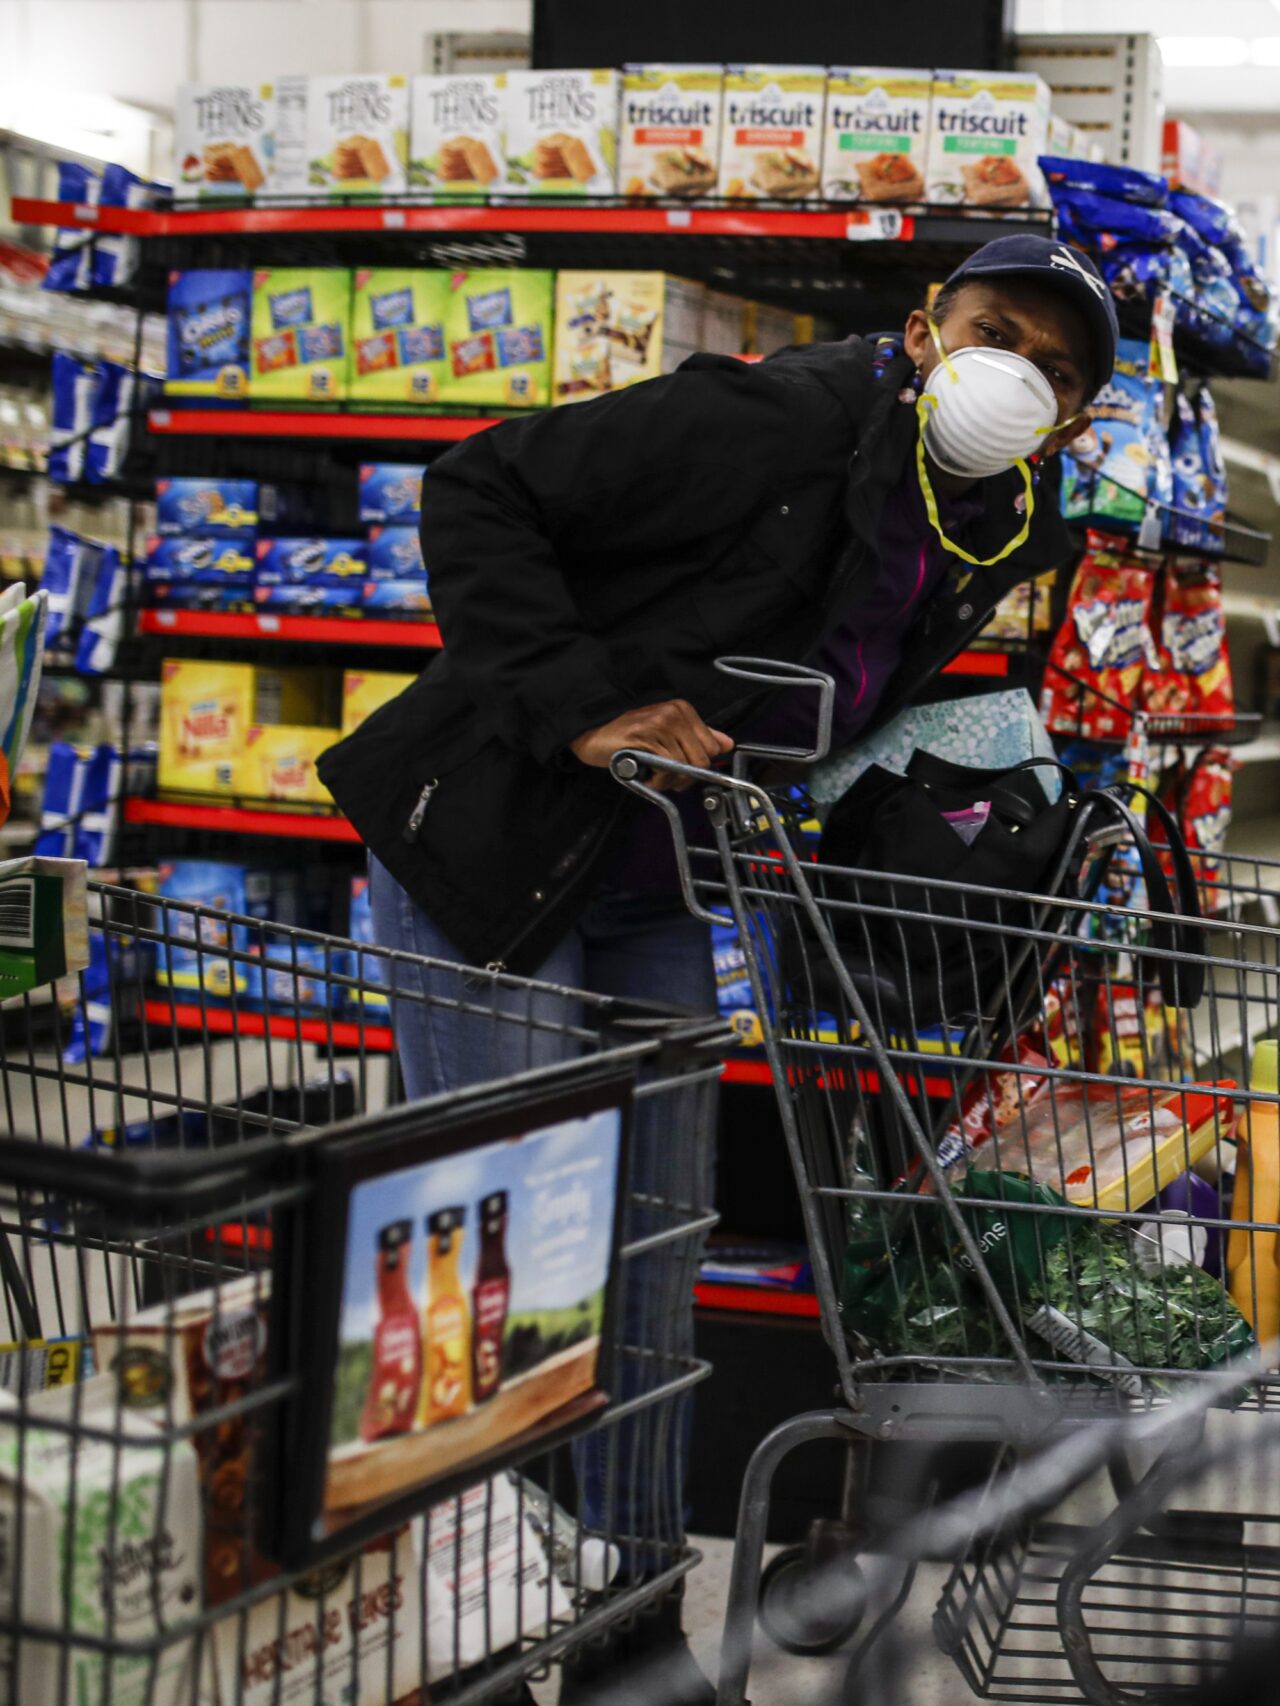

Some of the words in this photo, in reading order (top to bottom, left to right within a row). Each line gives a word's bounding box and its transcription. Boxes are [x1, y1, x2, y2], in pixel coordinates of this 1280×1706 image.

[193, 96, 264, 132] THINS
[326, 90, 392, 126] THINS
[429, 90, 499, 126] THINS
[524, 86, 596, 122] THINS
[628, 102, 711, 127] triscuit
[729, 102, 814, 127] triscuit
[833, 104, 921, 133] triscuit
[938, 107, 1028, 136] triscuit
[184, 711, 229, 738] Nilla
